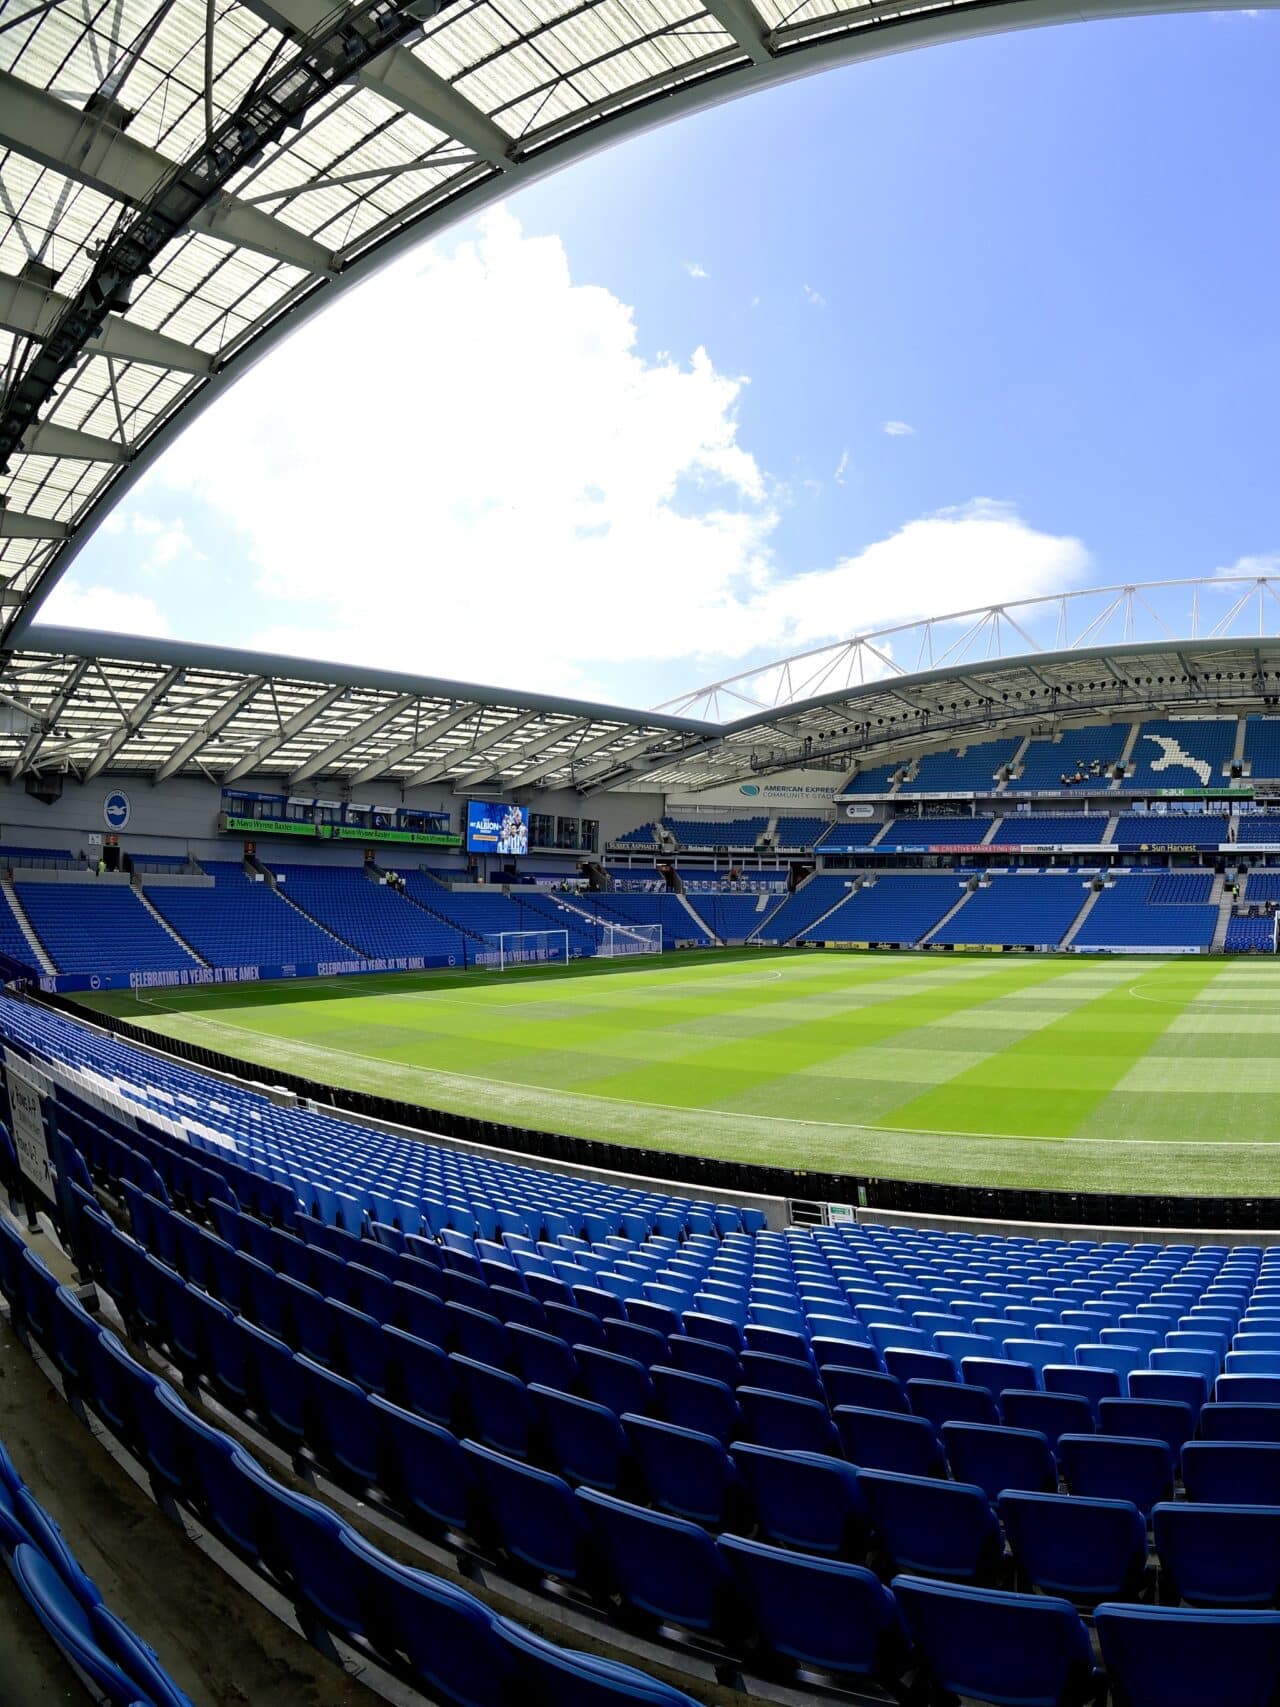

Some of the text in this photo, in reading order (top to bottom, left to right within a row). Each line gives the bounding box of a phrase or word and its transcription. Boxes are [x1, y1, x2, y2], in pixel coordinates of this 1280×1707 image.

[764, 785, 803, 793] AMERICAN
[763, 791, 810, 799] COMMUNITY
[1168, 844, 1197, 852] Harvest
[317, 960, 361, 976] CELEBRATING
[368, 958, 387, 971] YEARS
[388, 958, 396, 970] AT
[396, 957, 407, 970] THE
[408, 956, 426, 969] AMEX
[130, 966, 260, 988] CELEBRATING 10 YEARS AT THE AMEX
